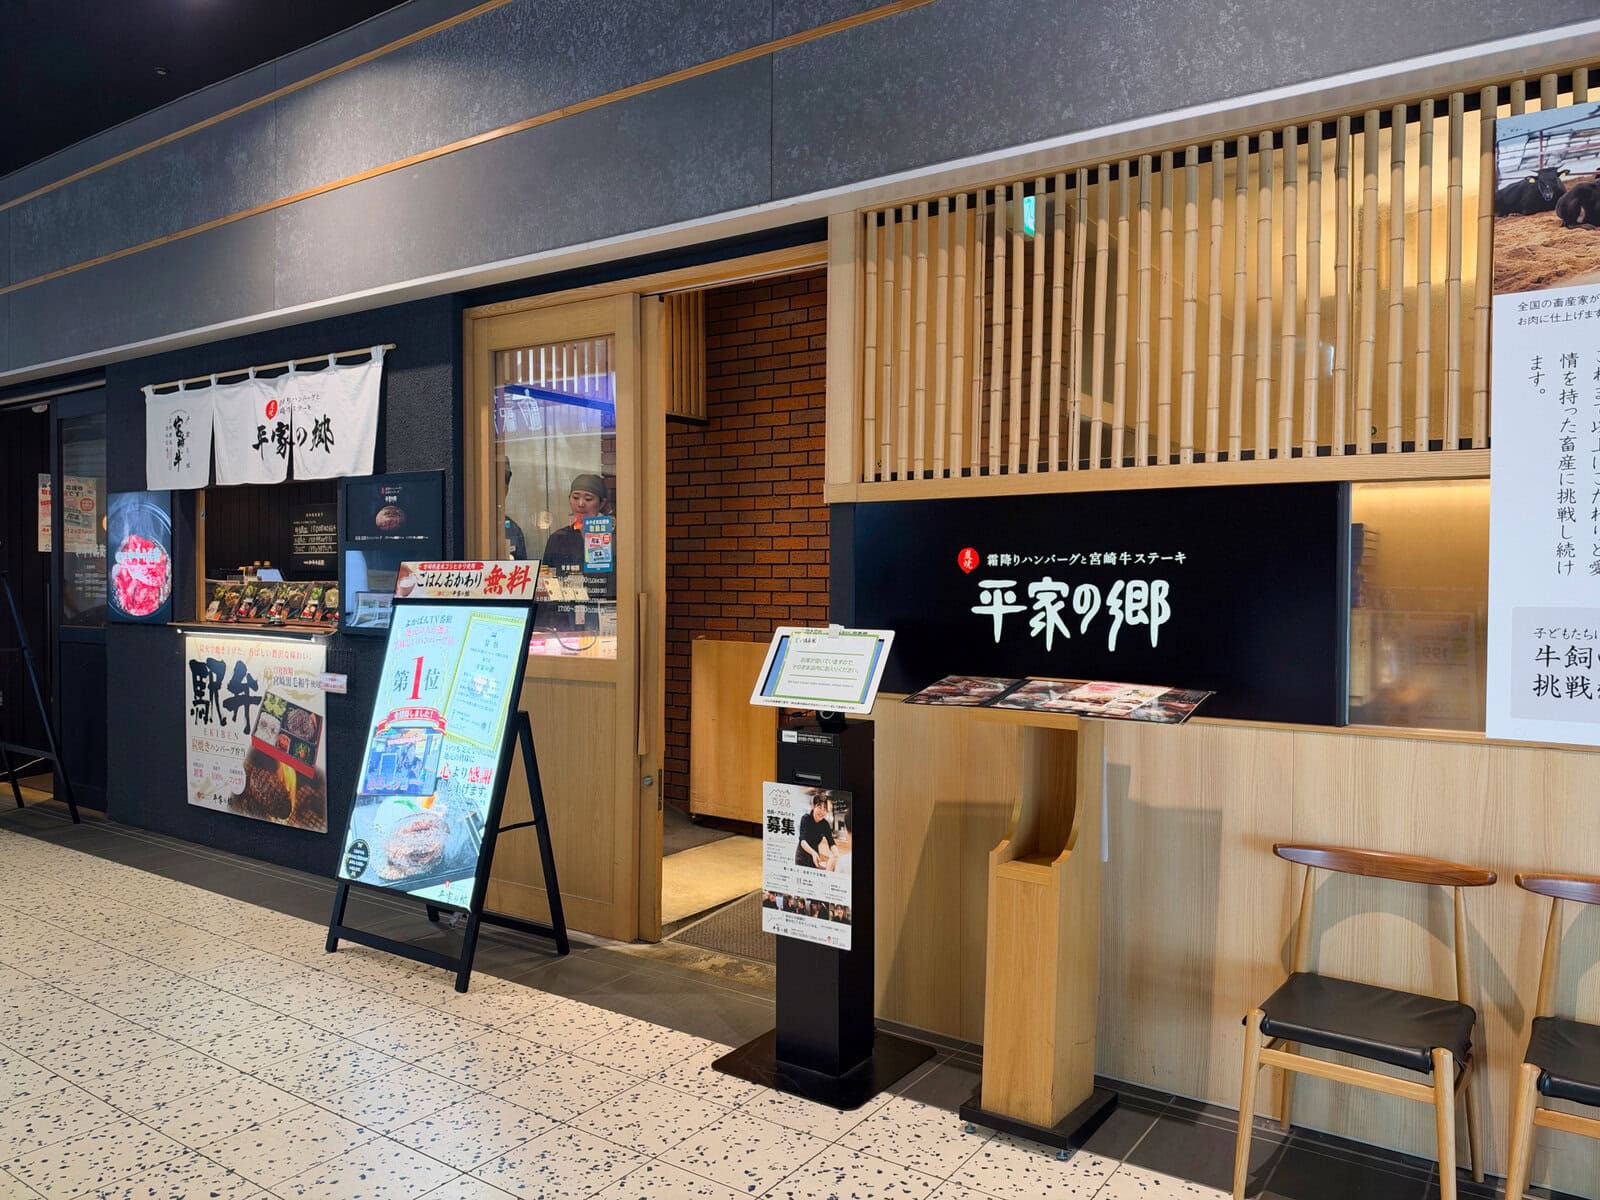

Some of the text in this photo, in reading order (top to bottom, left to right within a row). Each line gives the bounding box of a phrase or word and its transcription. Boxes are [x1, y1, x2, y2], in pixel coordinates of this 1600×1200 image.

[1517, 294, 1600, 312] 全国の畜産家が
[1528, 354, 1546, 396] ます。
[252, 413, 335, 461] 平家の郷
[1556, 351, 1580, 576] 情を持った畜産に挑戦し続け
[986, 551, 1188, 567] 霜降りハンバーグと宮崎牛ステーキ
[416, 571, 483, 589] ごはんおかわり
[483, 563, 532, 596] 無料
[970, 575, 1172, 653] 平家の郷
[1535, 644, 1600, 670] 牛飼
[392, 655, 441, 701] 第1位
[1532, 672, 1600, 700] 挑戦
[188, 656, 264, 736] 駅弁
[203, 727, 240, 741] EKIBEN
[440, 762, 493, 785] 心より感謝
[766, 815, 796, 836] 募集
